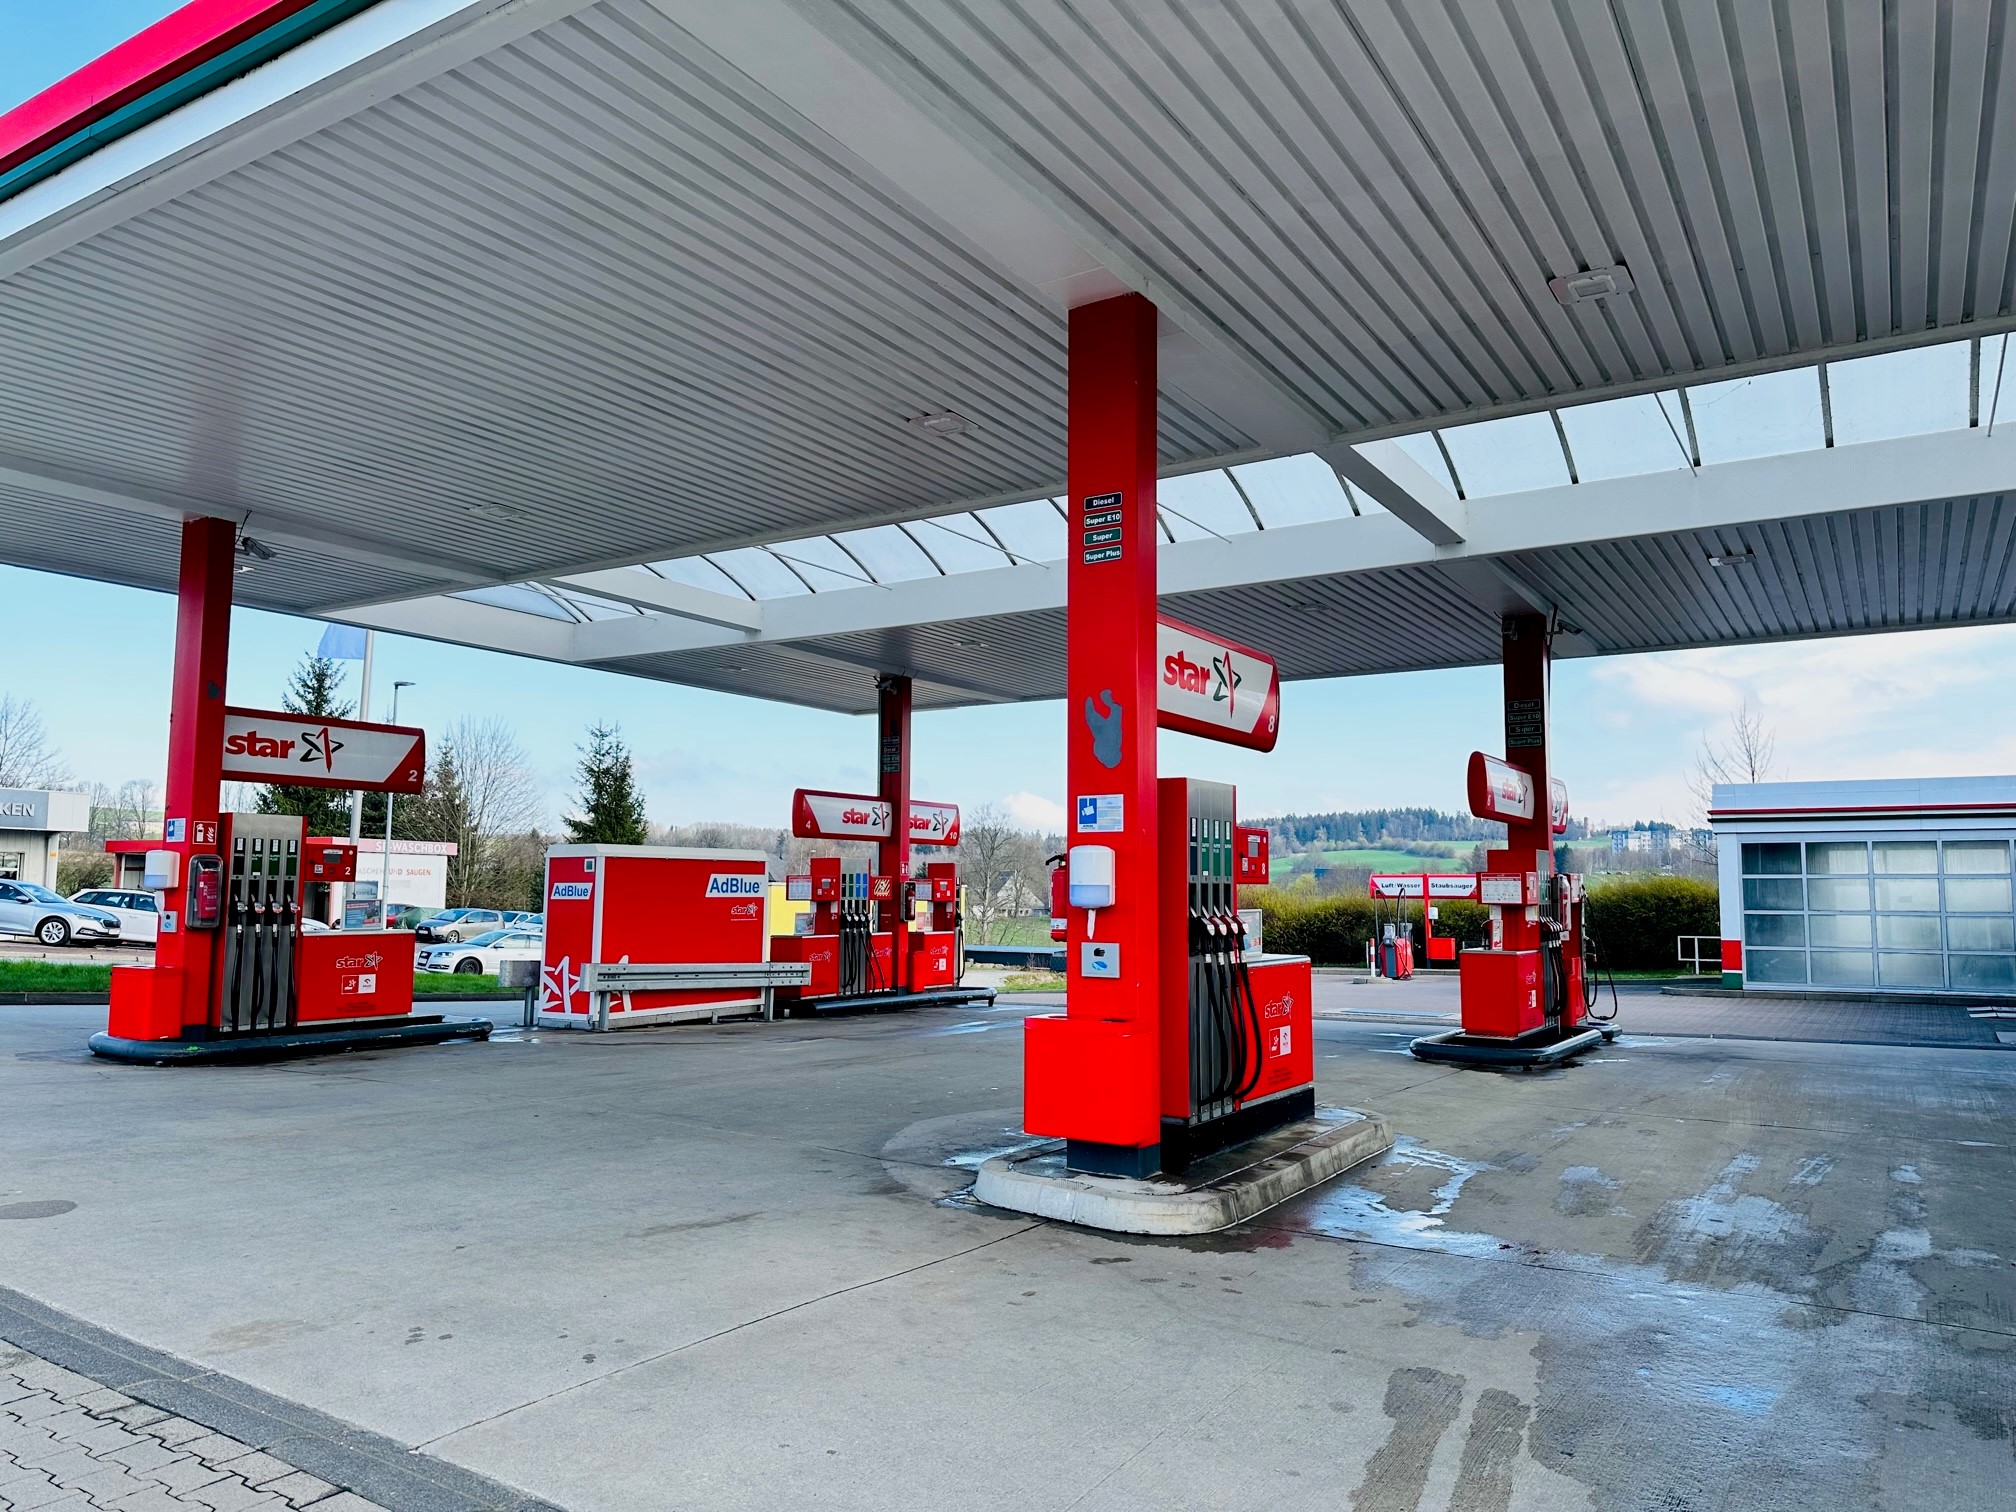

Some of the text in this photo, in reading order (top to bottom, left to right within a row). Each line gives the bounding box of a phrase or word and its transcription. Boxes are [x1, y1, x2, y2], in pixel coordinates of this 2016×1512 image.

[1093, 497, 1115, 506] Diesel
[1086, 513, 1120, 525] Super E10
[1092, 533, 1113, 542] Super
[1085, 552, 1105, 561] Super
[1163, 650, 1210, 695] star
[1267, 715, 1275, 733] 8
[1515, 726, 1535, 734] Super
[224, 731, 295, 759] star
[407, 769, 417, 782] 2
[842, 808, 871, 825] star
[909, 814, 932, 831] star
[805, 820, 811, 830] 4
[949, 831, 958, 840] 10
[344, 866, 351, 875] 2
[406, 868, 431, 876] SAUGEN
[1261, 862, 1266, 875] 8
[553, 885, 589, 897] AdBlue
[709, 877, 760, 893] AdBlue
[731, 905, 747, 915] star
[336, 956, 364, 968] star
[1264, 1000, 1282, 1018] star
